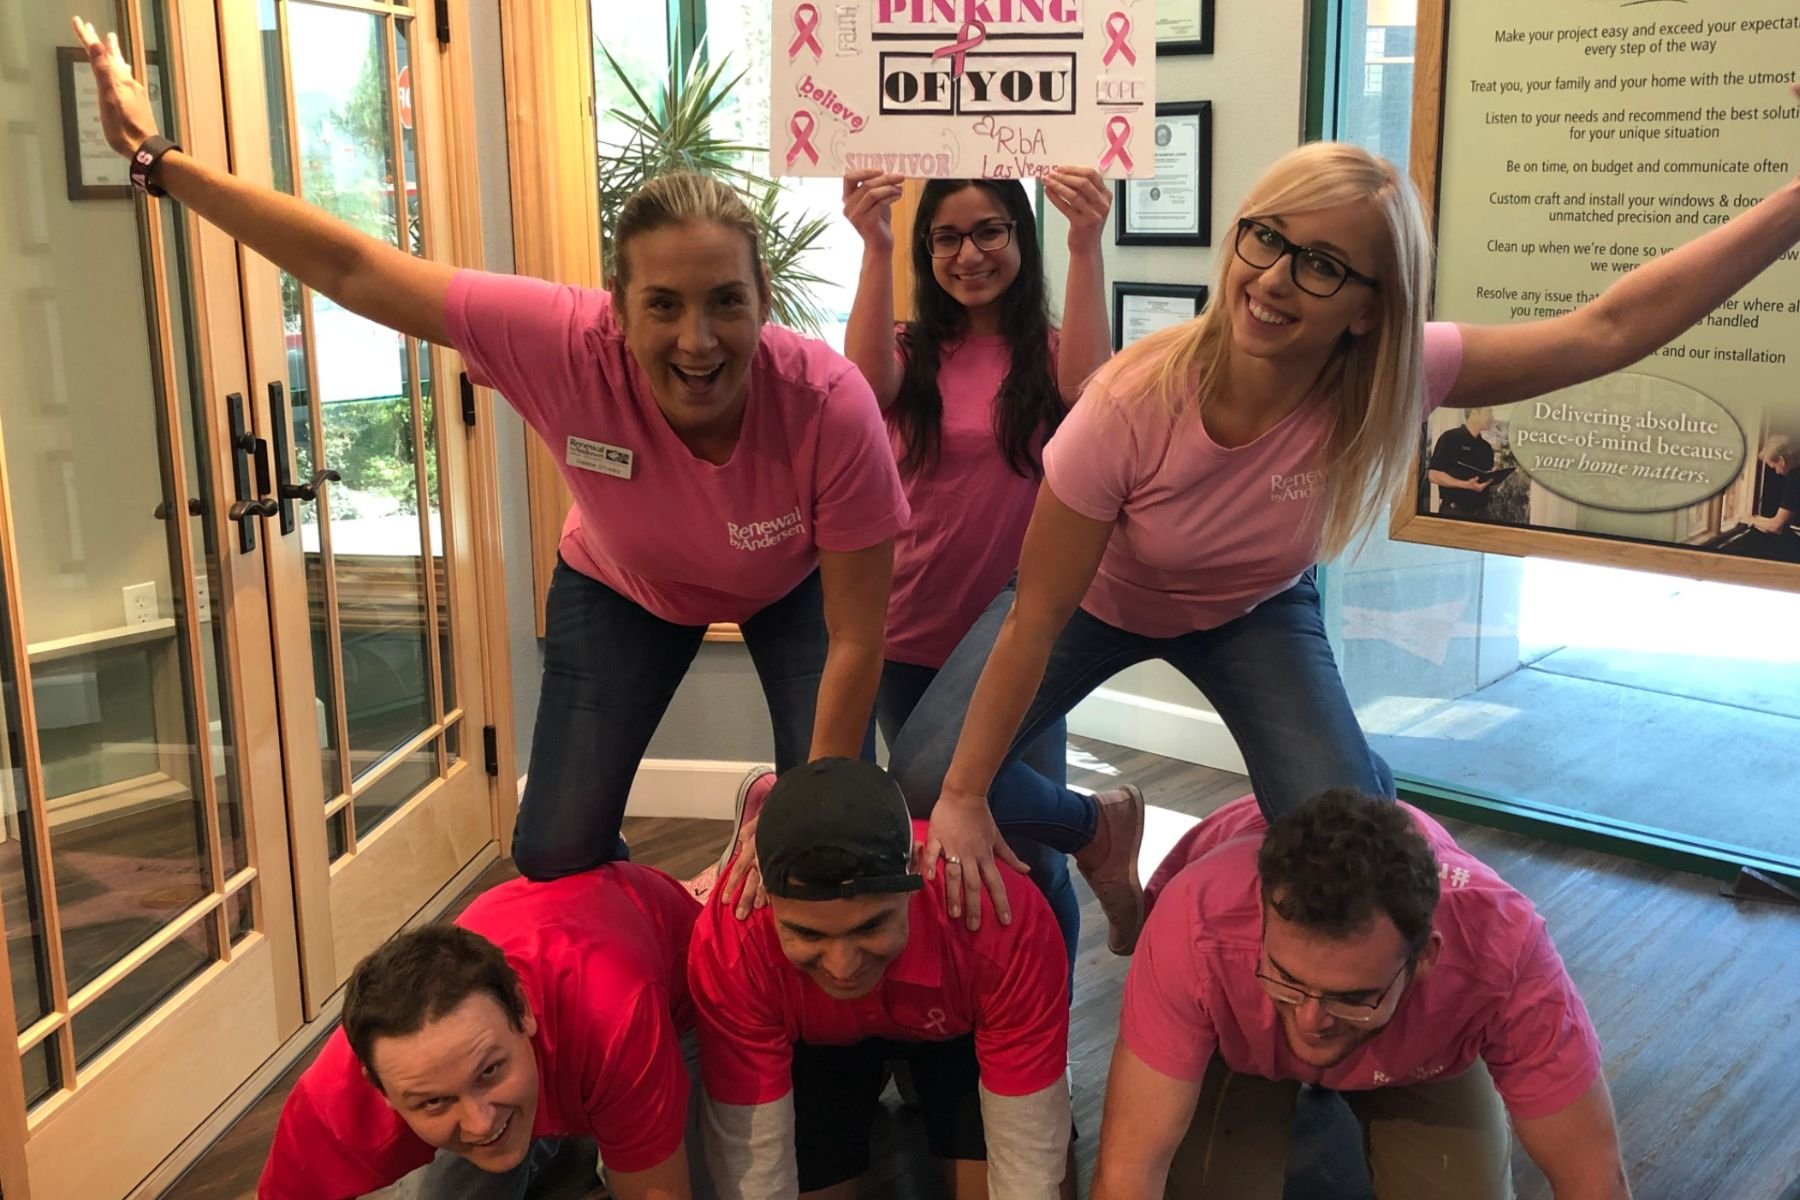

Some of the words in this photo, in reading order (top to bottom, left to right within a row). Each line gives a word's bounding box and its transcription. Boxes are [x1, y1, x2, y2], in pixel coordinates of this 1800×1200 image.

[876, 0, 1078, 24] PINKING
[1495, 29, 1526, 43] Make
[1529, 30, 1553, 45] your
[1557, 26, 1598, 43] project
[1601, 27, 1629, 40] easy
[1632, 22, 1656, 36] and
[1660, 20, 1704, 35] exceed
[1707, 21, 1737, 36] your
[1740, 16, 1800, 34] expectat
[1584, 45, 1617, 58] every
[1620, 42, 1646, 56] step
[1650, 39, 1663, 53] of
[1666, 38, 1687, 53] the
[1690, 40, 1717, 54] way
[885, 71, 951, 103] OF
[965, 70, 1069, 103] YOU
[1470, 80, 1497, 92] Treat
[1500, 80, 1523, 95] you,
[1526, 80, 1552, 94] your
[1555, 76, 1591, 93] family
[1594, 75, 1617, 89] and
[1620, 77, 1647, 92] your
[1651, 74, 1686, 87] home
[1690, 72, 1719, 86] with
[1723, 71, 1744, 85] the
[1748, 70, 1796, 84] utmost
[800, 75, 863, 128] believe
[1485, 112, 1517, 124] Listen
[1521, 112, 1532, 124] to
[1535, 112, 1561, 127] your
[1564, 109, 1599, 123] needs
[1602, 108, 1625, 122] and
[1628, 107, 1701, 122] recommend
[1706, 106, 1727, 121] the
[1730, 105, 1758, 120] best
[996, 126, 1047, 155] RbA
[1569, 126, 1586, 139] for
[1589, 128, 1616, 142] your
[1619, 126, 1661, 142] unique
[1664, 124, 1720, 139] situation
[845, 152, 950, 176] SURVIVOR
[982, 155, 1012, 179] Las
[1506, 160, 1521, 173] Be
[1523, 162, 1538, 173] on
[1542, 160, 1569, 174] time,
[1572, 162, 1588, 173] on
[1591, 159, 1634, 176] budget
[1636, 159, 1660, 173] and
[1663, 159, 1750, 173] communicate
[1753, 158, 1789, 173] often
[1489, 192, 1531, 205] Custom
[1534, 192, 1561, 205] craft
[1563, 192, 1586, 206] and
[1589, 192, 1625, 206] install
[1628, 195, 1656, 209] your
[1659, 193, 1715, 207] windows
[1719, 194, 1729, 208] &
[1549, 210, 1614, 223] unmatched
[1617, 210, 1671, 225] precision
[1675, 211, 1699, 224] and
[1702, 214, 1730, 225] care
[1487, 239, 1518, 252] Clean
[1521, 243, 1535, 256] up
[1539, 241, 1570, 254] when
[1573, 241, 1606, 255] we're
[1609, 243, 1639, 256] done
[1643, 245, 1657, 257] so
[1590, 262, 1608, 272] we
[1476, 286, 1518, 300] Resolve
[1521, 290, 1542, 304] any
[1544, 289, 1573, 303] issue
[1576, 290, 1600, 303] that
[1743, 298, 1784, 312] where
[1510, 306, 1531, 319] you
[1707, 314, 1759, 328] handled
[1662, 345, 1685, 357] and
[1689, 348, 1710, 360] our
[1714, 346, 1786, 364] installation
[1535, 402, 1632, 432] Delivering
[1636, 411, 1718, 434] absolute
[1517, 429, 1651, 453] peace-of-mind
[1657, 438, 1734, 461] because
[1534, 455, 1574, 470] your
[1578, 453, 1628, 475] home
[1632, 463, 1710, 484] matters.
[728, 506, 801, 540] Renewal
[729, 536, 741, 550] by
[741, 523, 806, 551] Andersen
